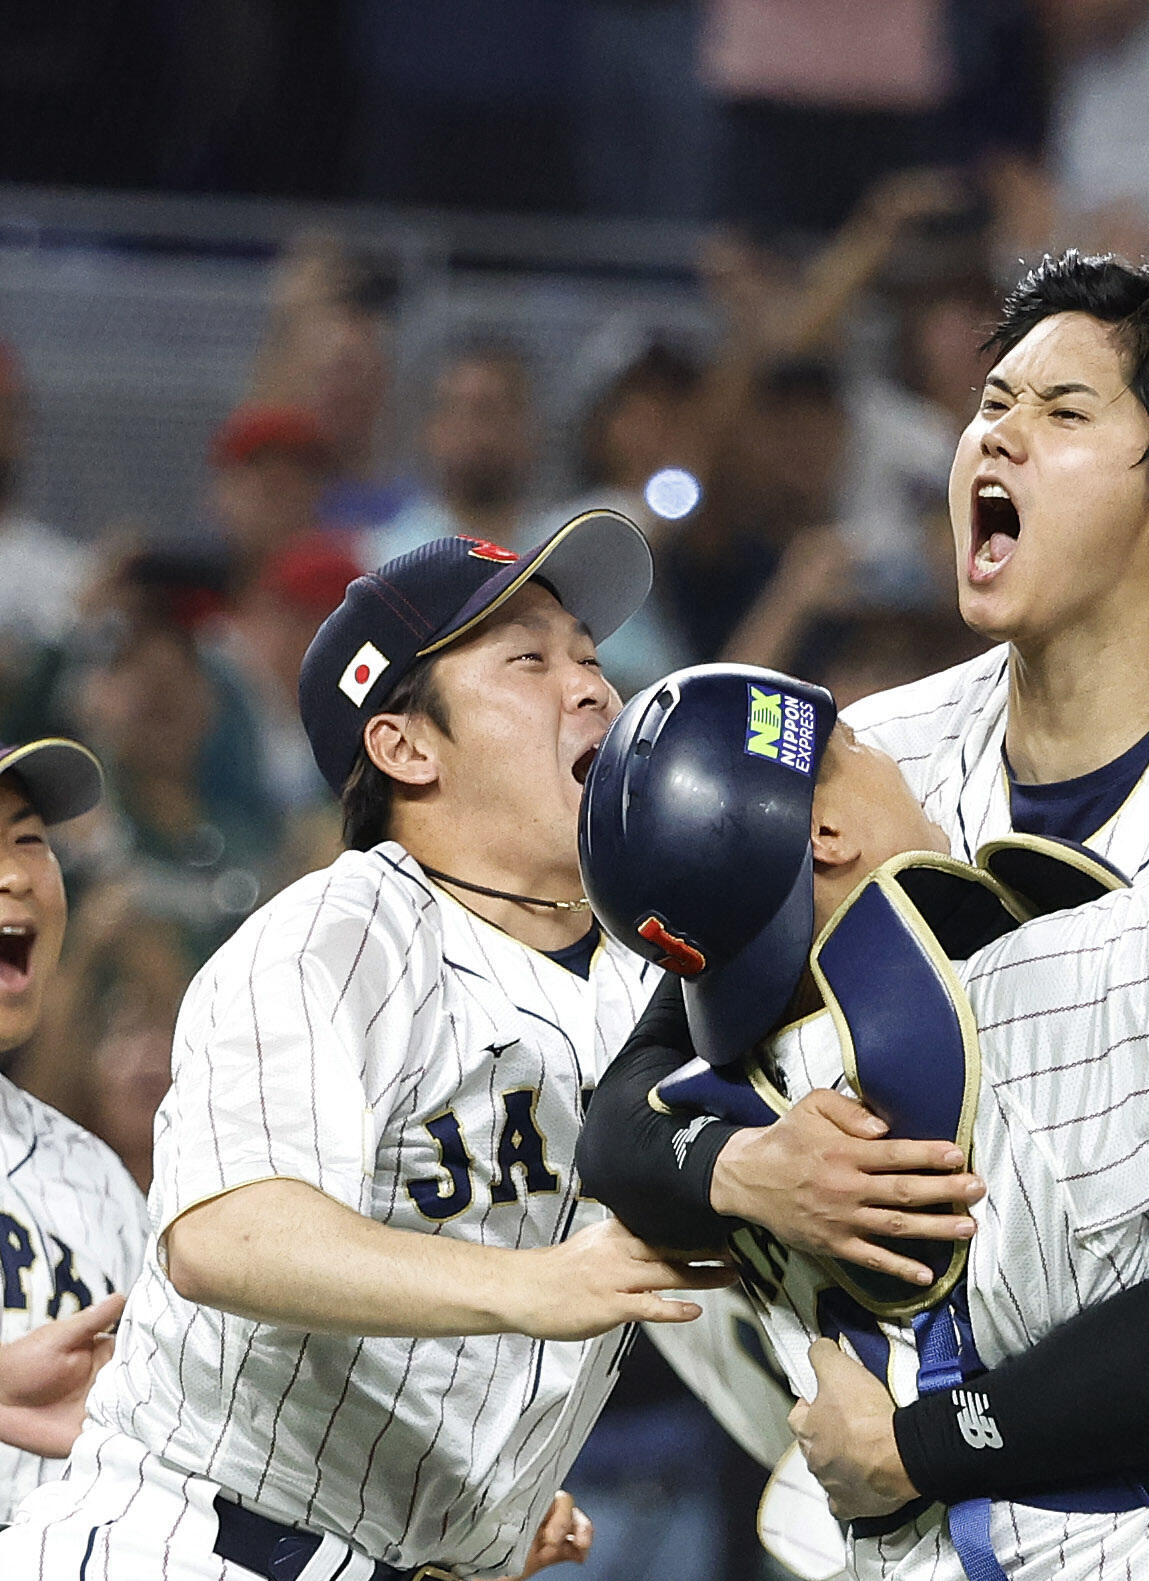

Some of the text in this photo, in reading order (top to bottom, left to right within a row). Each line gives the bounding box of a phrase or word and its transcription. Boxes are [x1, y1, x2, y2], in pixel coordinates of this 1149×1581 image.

[747, 686, 782, 759] NX
[780, 695, 801, 767] NIPPON
[795, 701, 815, 773] EXPRESS
[405, 1084, 605, 1222] JA
